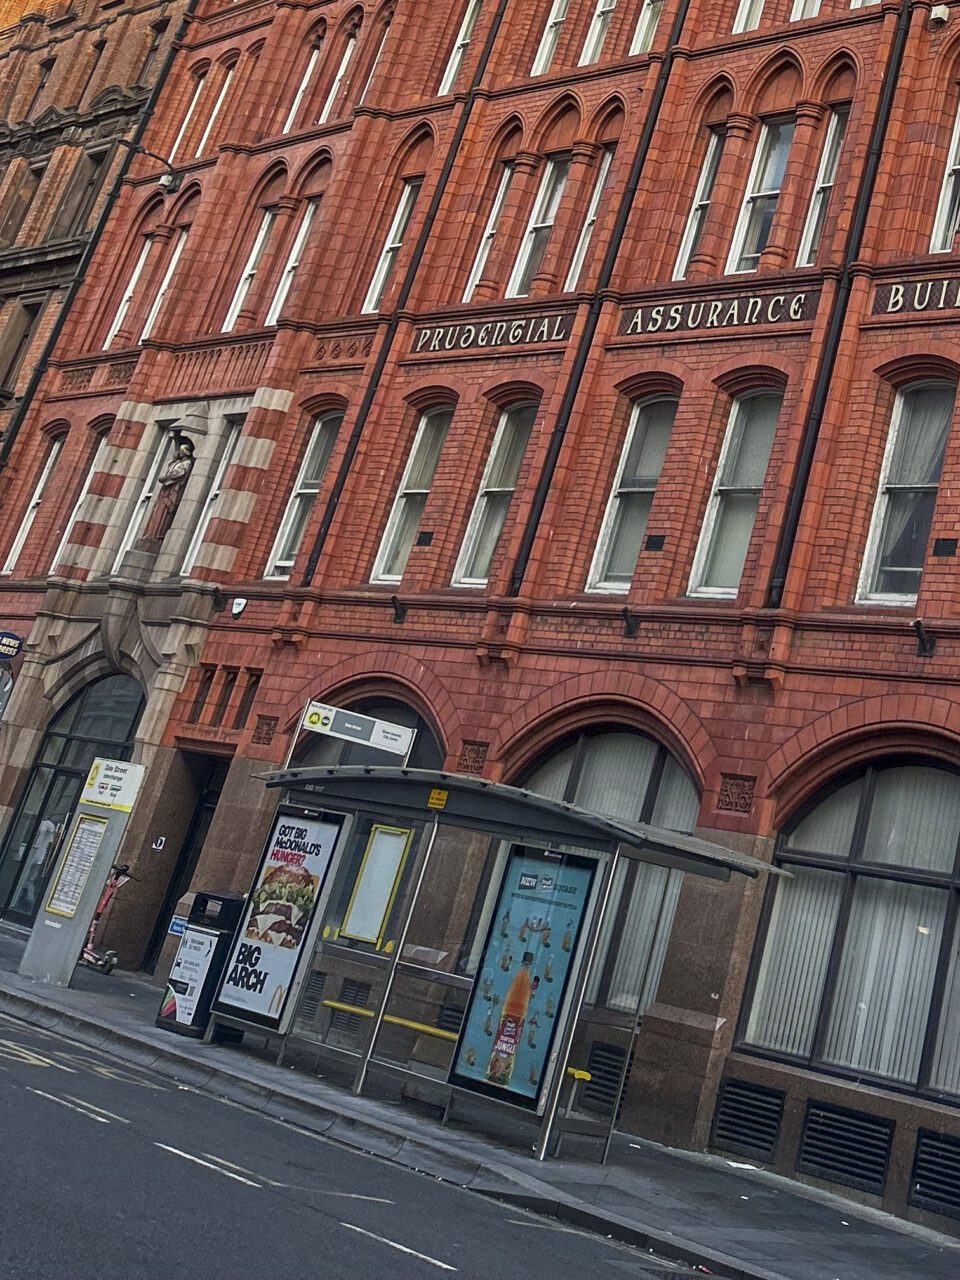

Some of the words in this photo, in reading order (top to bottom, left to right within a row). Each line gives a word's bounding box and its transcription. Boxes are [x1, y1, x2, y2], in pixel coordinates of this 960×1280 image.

[416, 316, 566, 352] PRUDENTIAL
[626, 293, 805, 335] ASSURANCE
[278, 824, 294, 838] GOT
[295, 827, 308, 840] BIG
[270, 849, 307, 866] HUNGER?
[274, 836, 322, 857] McDONALD'S
[235, 942, 262, 968] BIG
[226, 964, 270, 994] ARCH
